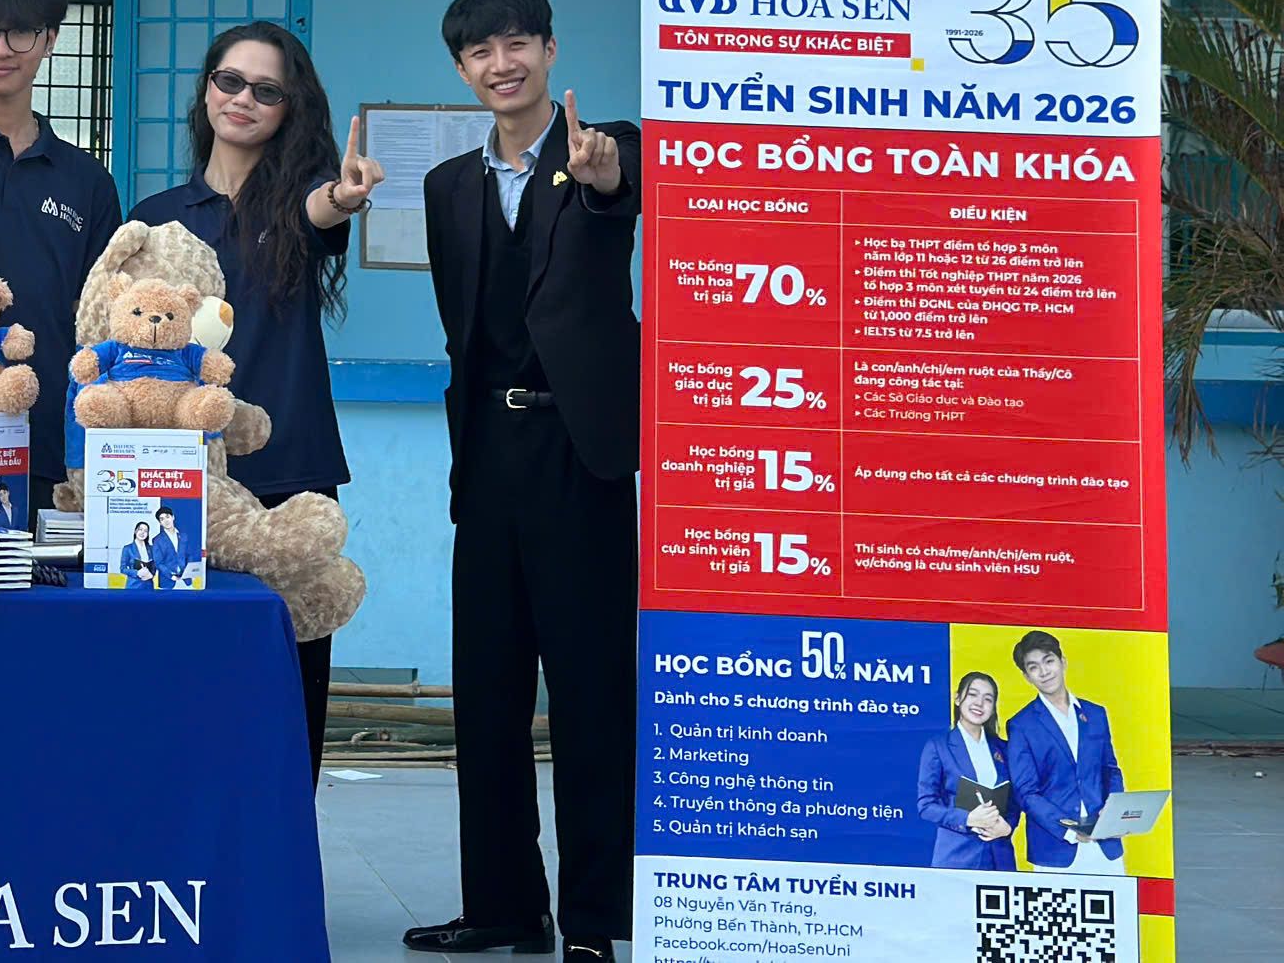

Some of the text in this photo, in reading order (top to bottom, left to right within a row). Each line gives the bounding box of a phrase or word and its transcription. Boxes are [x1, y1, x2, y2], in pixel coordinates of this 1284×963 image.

[674, 30, 894, 55] TÔN TRỌNG SỰ KHÁC BIỆT
[658, 72, 1136, 124] TUYỂN SINH NĂM 2026
[659, 135, 1135, 181] HỌC BỔNG TOÀN KHÓA
[688, 198, 723, 213] LOẠI
[727, 199, 760, 214] HỌC
[991, 207, 1027, 224] KIỆN
[669, 259, 695, 272] Học
[677, 275, 733, 287] tinh hoa
[735, 264, 827, 306] 70%
[694, 290, 733, 305] trị giá
[864, 326, 974, 340] IELTS từ 7.5 trở lên
[739, 366, 827, 409] 25%
[140, 470, 184, 481] KHÁC BIỆT
[758, 450, 835, 492] 15%
[655, 631, 931, 684] HỌC BỔNG 50% NĂM 1
[654, 691, 920, 717] Dành cho 5 chương trình đào tạo
[654, 795, 903, 821] 4. Truyền thông đa phương tiện
[654, 872, 916, 899] TRUNG TÂM TUYỂN SINH
[53, 880, 206, 948] SEN
[654, 896, 817, 917] 08 Nguyễn Văn Tráng,
[654, 936, 851, 957] Facebook.com/HoaSenUni
